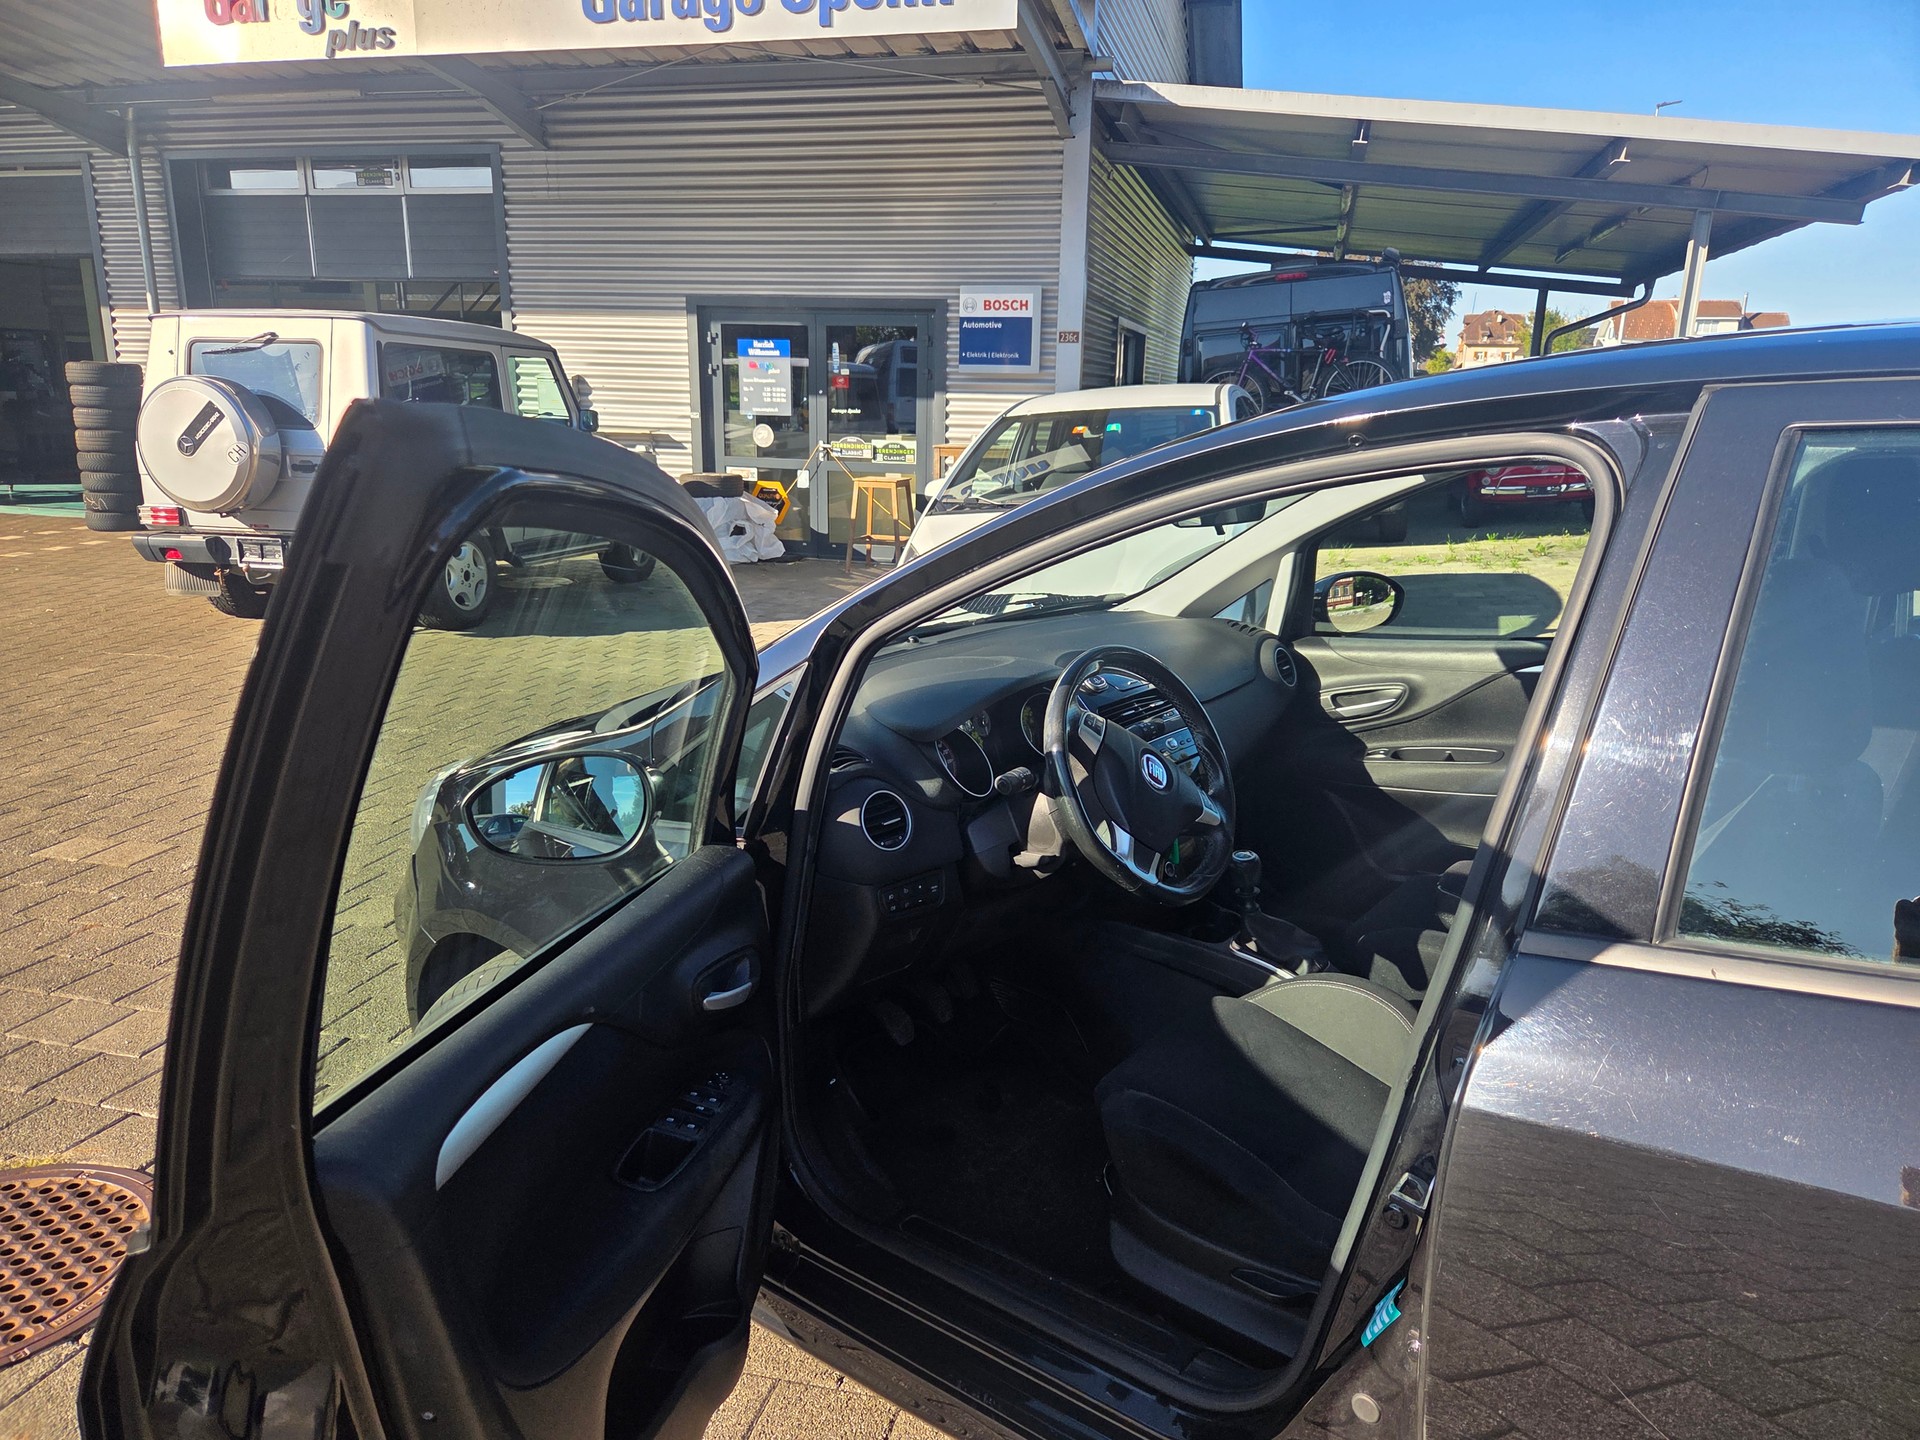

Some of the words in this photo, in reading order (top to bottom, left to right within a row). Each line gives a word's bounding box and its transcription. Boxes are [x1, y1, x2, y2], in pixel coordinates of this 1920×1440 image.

[204, 0, 350, 35] Garge
[326, 20, 397, 58] plus
[983, 299, 1029, 311] BOSCH
[962, 321, 1003, 329] Automotive
[1060, 332, 1078, 342] 236c
[991, 351, 1019, 359] Elektronik
[227, 444, 247, 463] CH
[1148, 760, 1163, 782] FIAT
